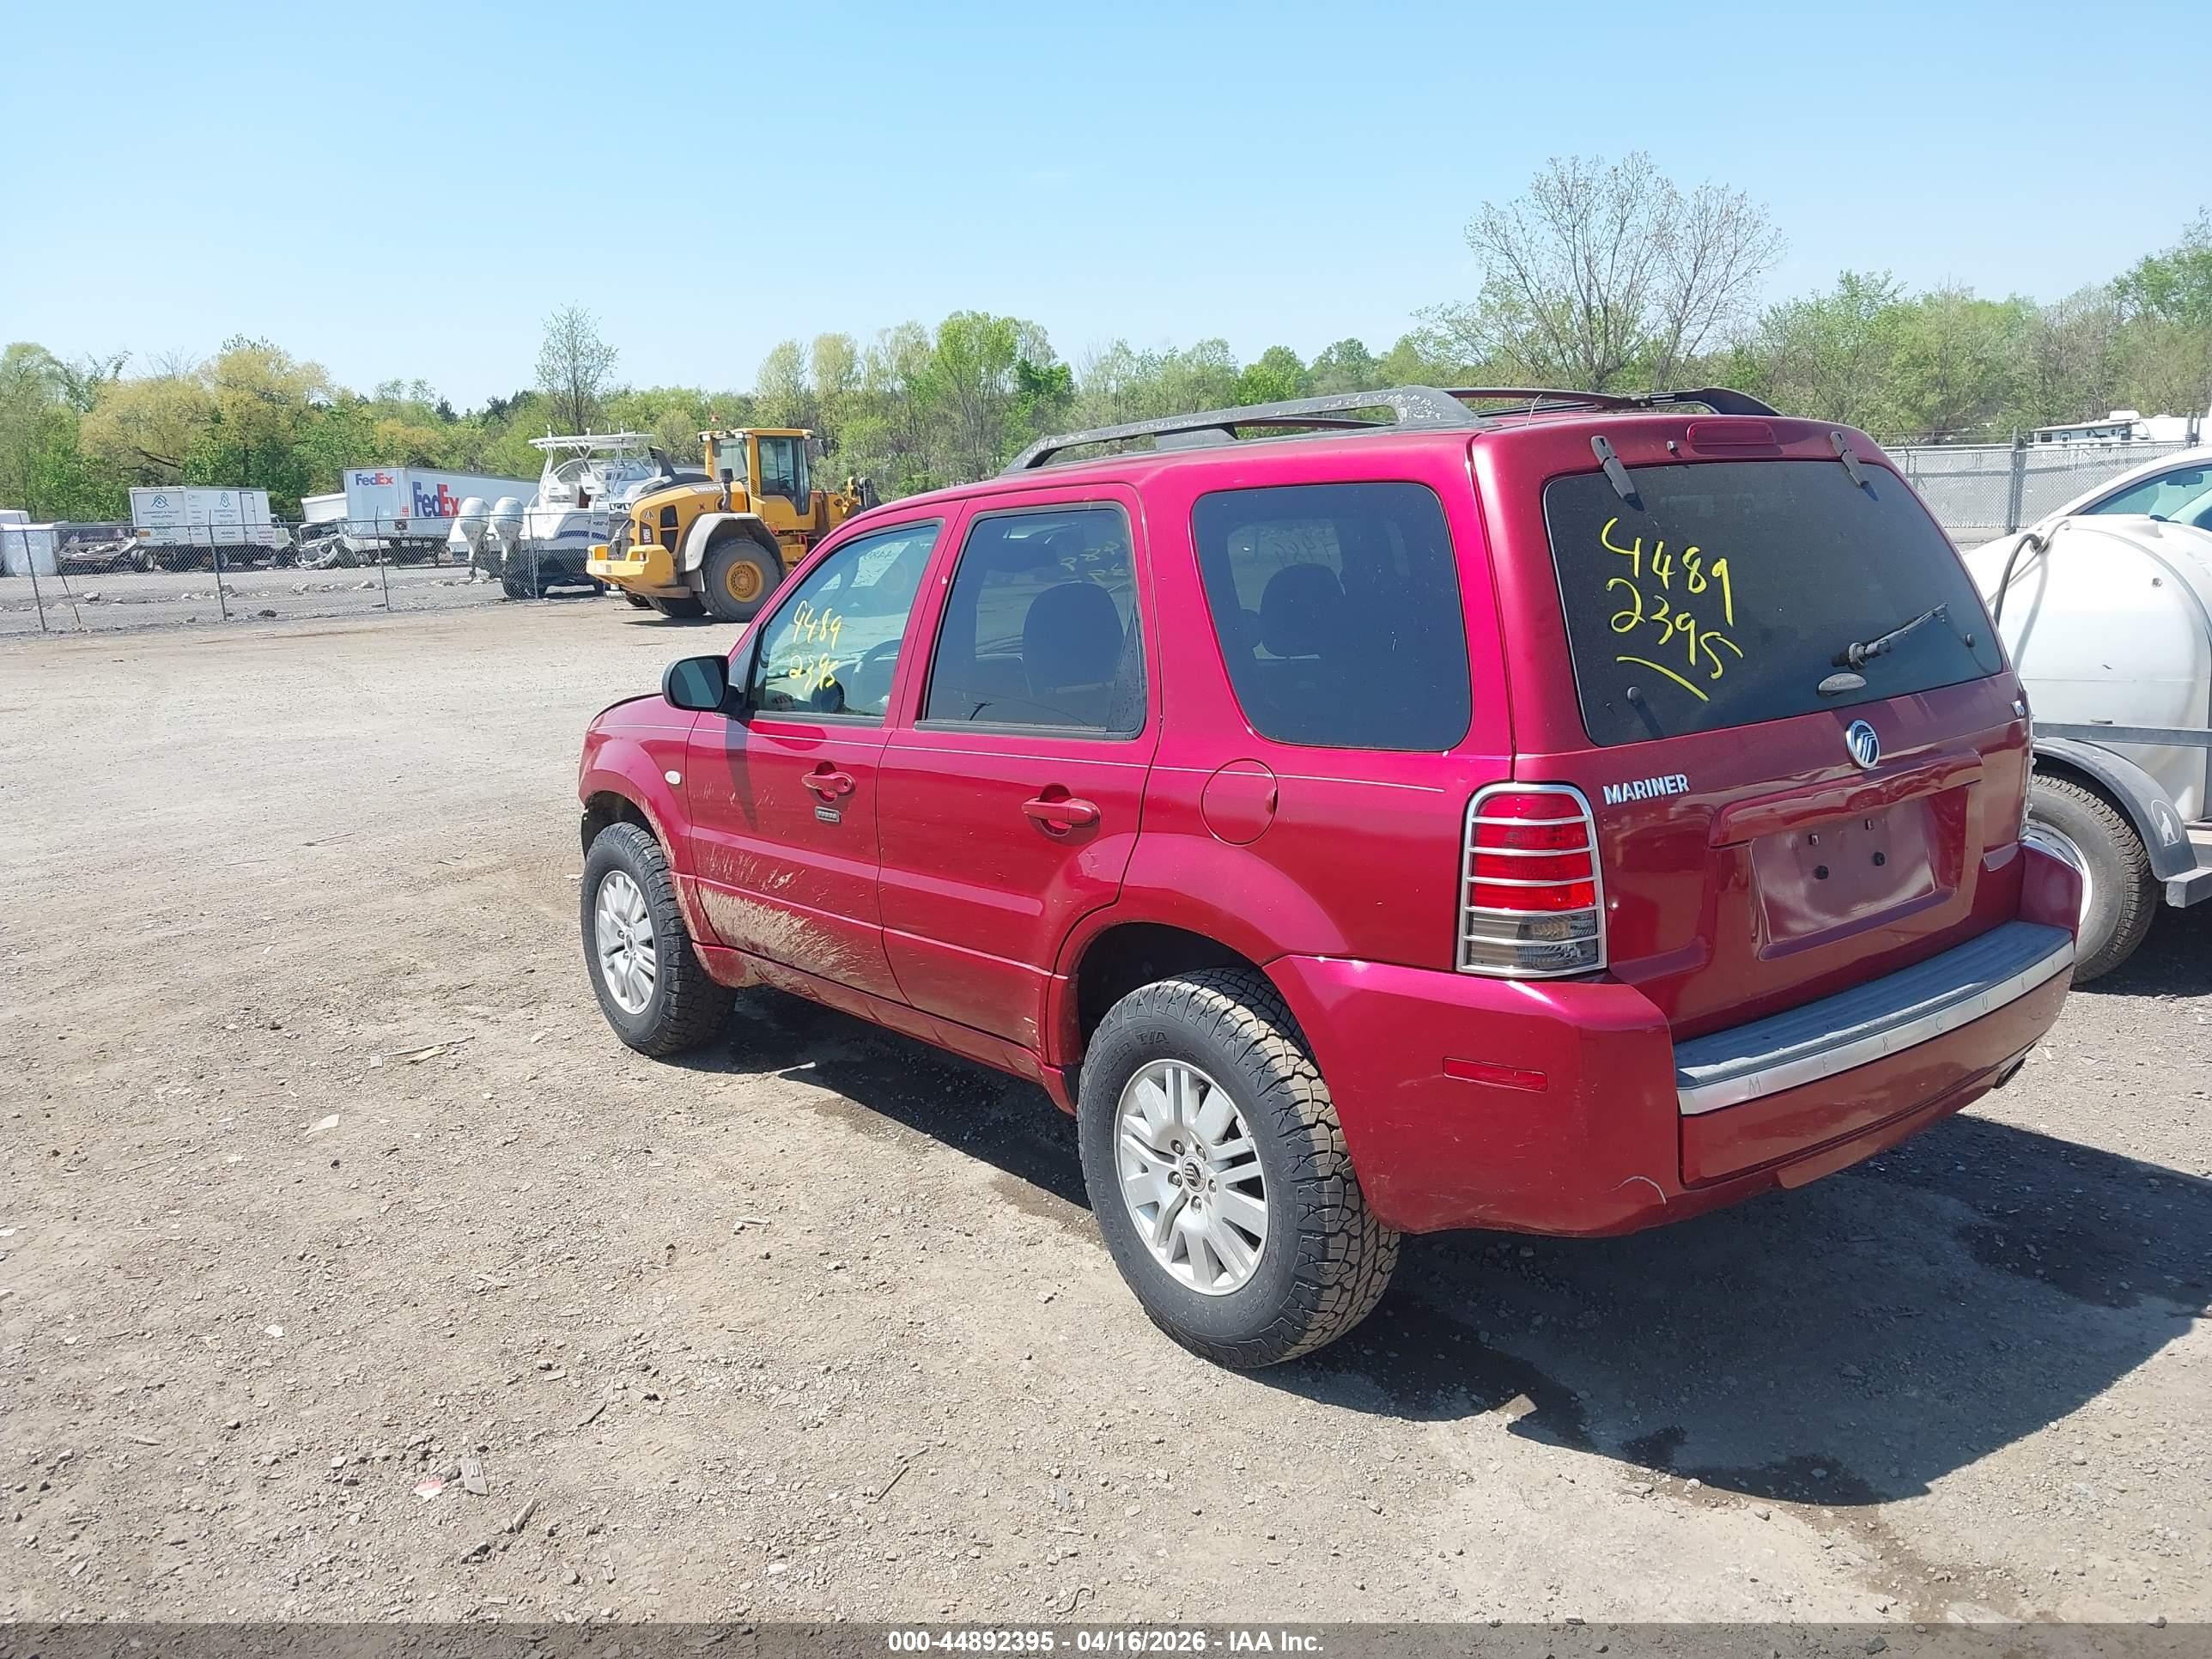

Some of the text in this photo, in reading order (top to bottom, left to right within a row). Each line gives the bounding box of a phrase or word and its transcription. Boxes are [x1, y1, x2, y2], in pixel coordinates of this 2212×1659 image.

[355, 472, 393, 486] FedEx
[412, 481, 459, 517] FedEx
[1601, 517, 1734, 628] 4489
[1606, 578, 1744, 679] 2395
[1602, 774, 1690, 805] MARINER
